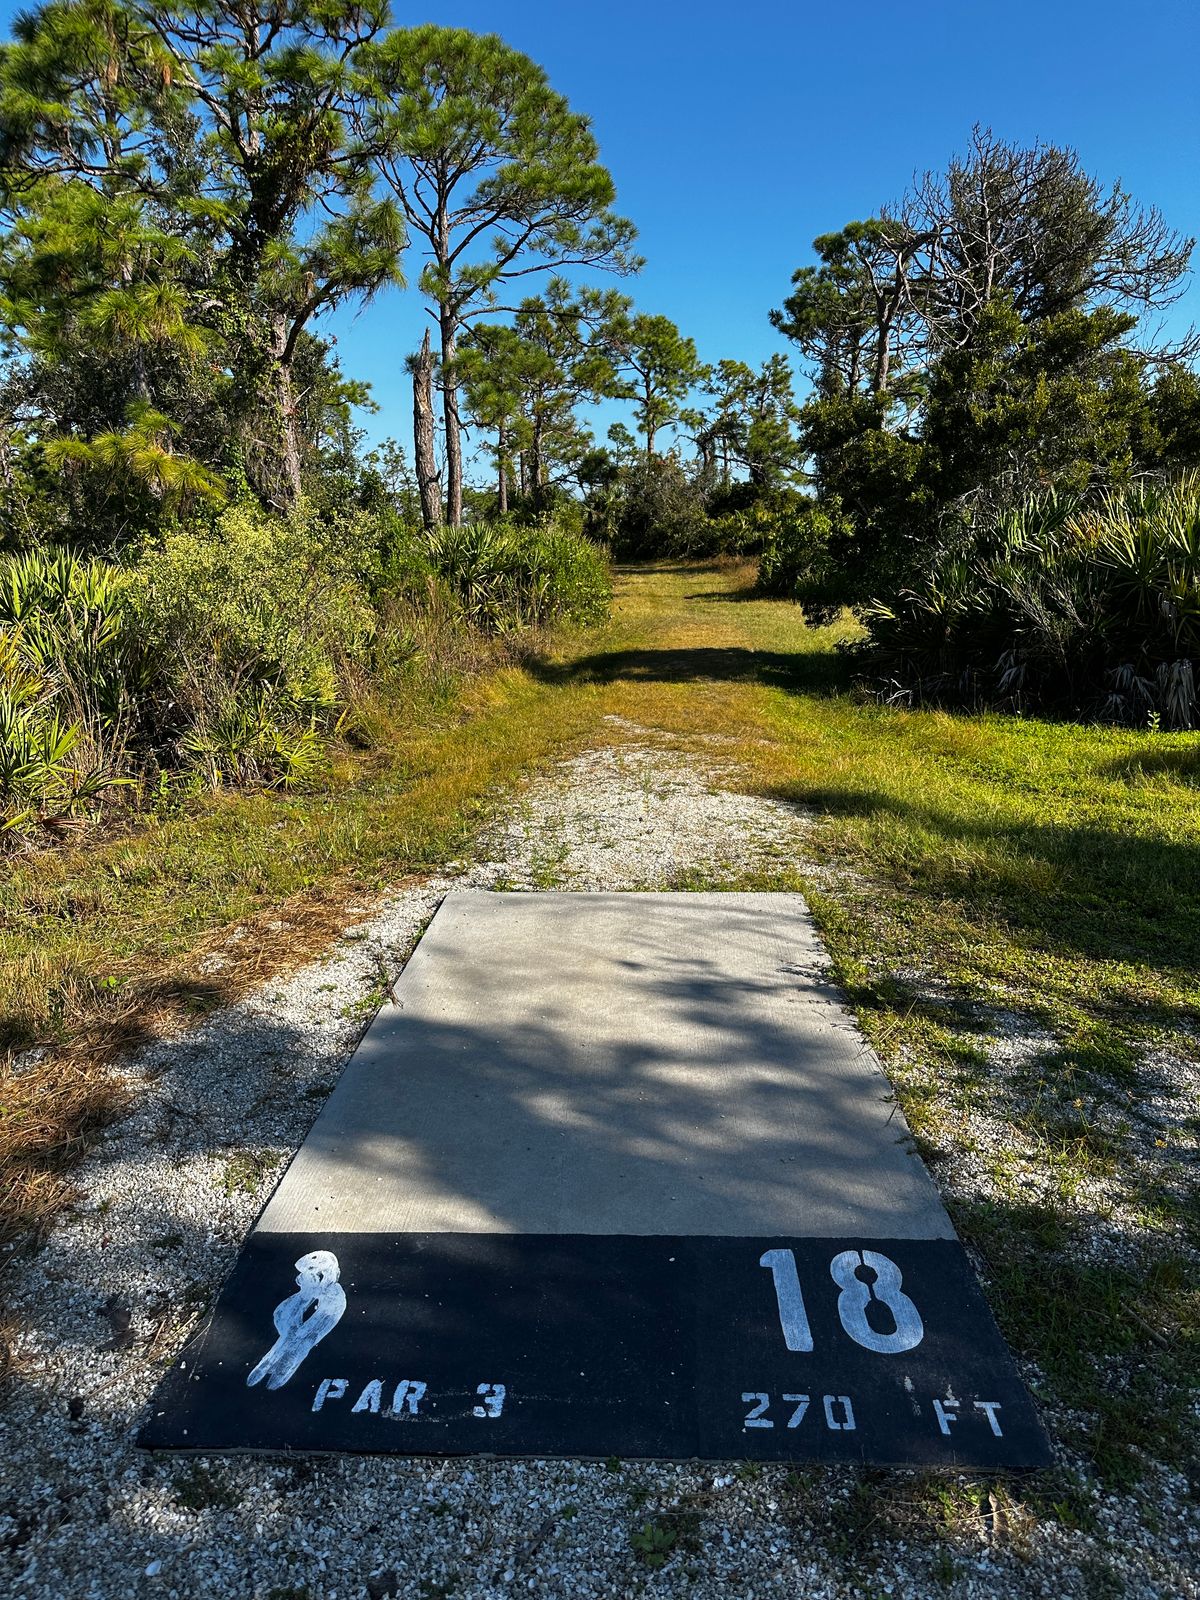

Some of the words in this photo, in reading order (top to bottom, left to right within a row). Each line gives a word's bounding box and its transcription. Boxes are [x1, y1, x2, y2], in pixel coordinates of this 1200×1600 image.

[759, 1248, 924, 1354] 18
[311, 1378, 427, 1414] PAR
[473, 1383, 506, 1418] 3
[741, 1392, 856, 1430] 270
[932, 1399, 1003, 1437] FT
